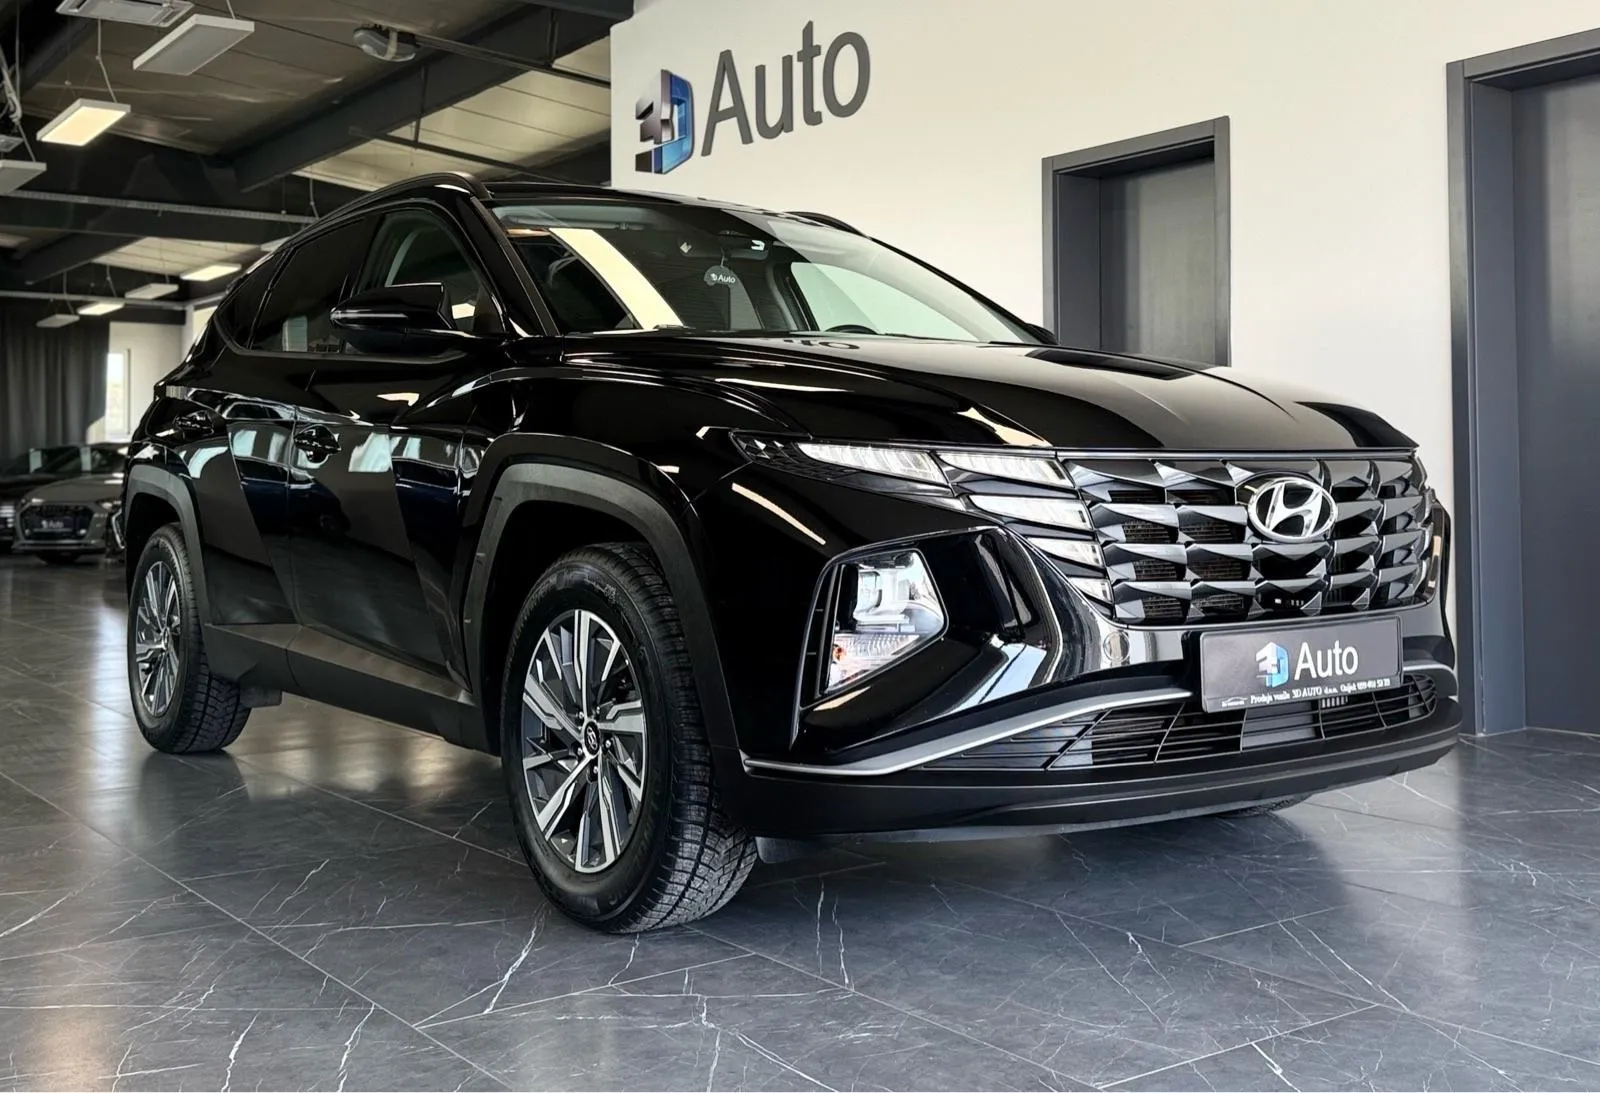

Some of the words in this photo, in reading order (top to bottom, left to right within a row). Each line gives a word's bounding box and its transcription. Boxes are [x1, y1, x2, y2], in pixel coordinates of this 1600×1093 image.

[701, 20, 871, 157] Auto
[717, 274, 736, 284] Auto
[1294, 639, 1359, 681] Auto
[1302, 687, 1322, 697] AUTO
